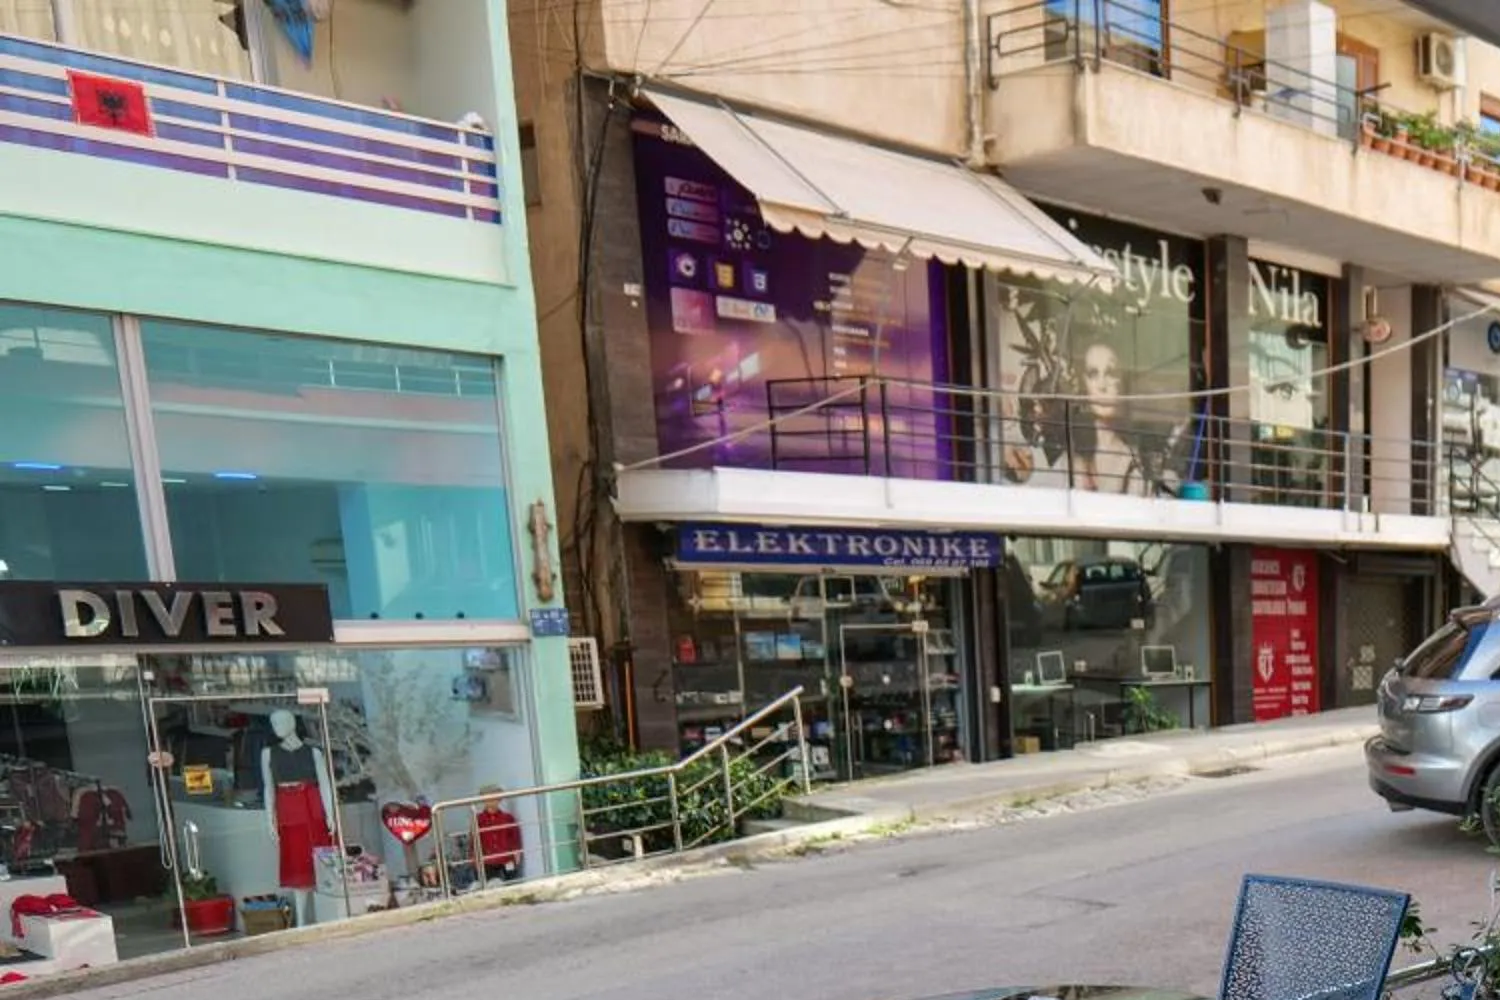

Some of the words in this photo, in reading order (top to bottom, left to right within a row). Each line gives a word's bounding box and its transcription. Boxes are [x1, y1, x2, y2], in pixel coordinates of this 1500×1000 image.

[1249, 261, 1322, 327] Nila
[693, 529, 991, 558] ELEKTRONIKE
[58, 589, 286, 638] DIVER
